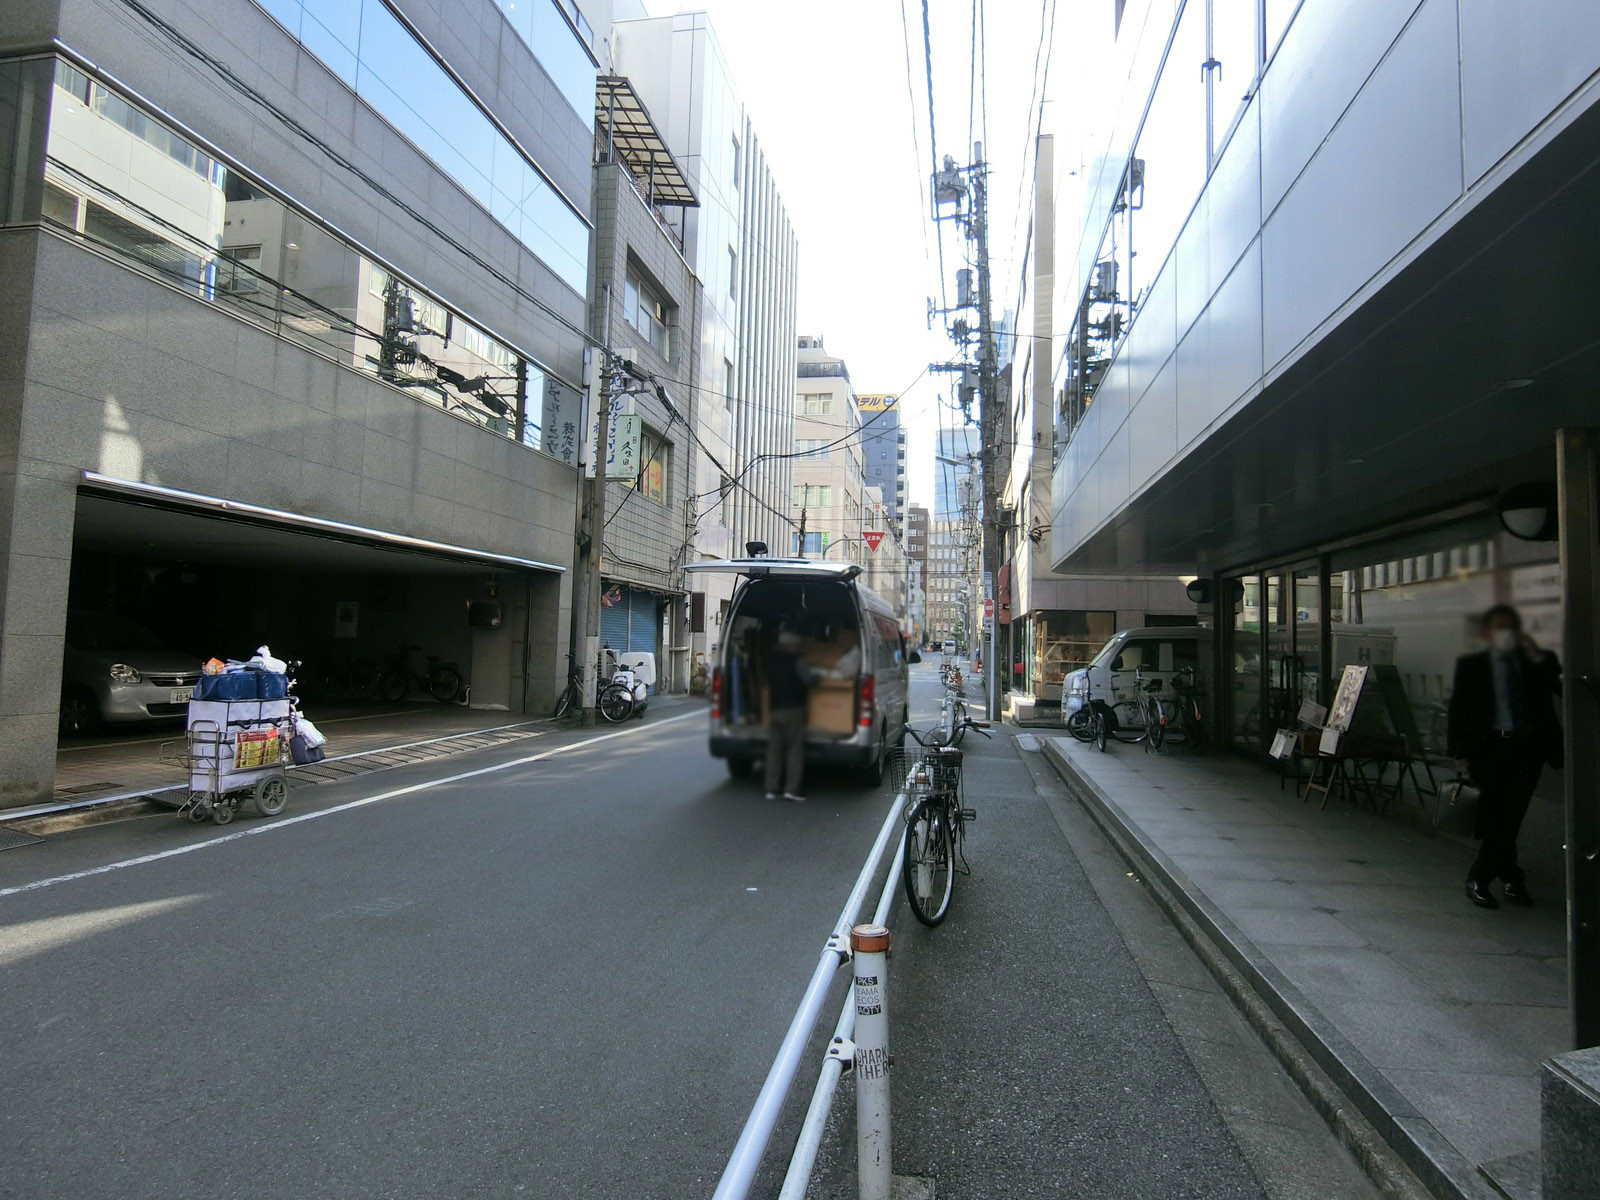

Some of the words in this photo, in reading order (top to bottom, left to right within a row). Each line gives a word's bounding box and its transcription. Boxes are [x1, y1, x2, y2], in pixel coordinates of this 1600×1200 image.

[856, 987, 879, 996] YAMA
[857, 995, 880, 1005] ECOS
[857, 1045, 888, 1065] SHARK
